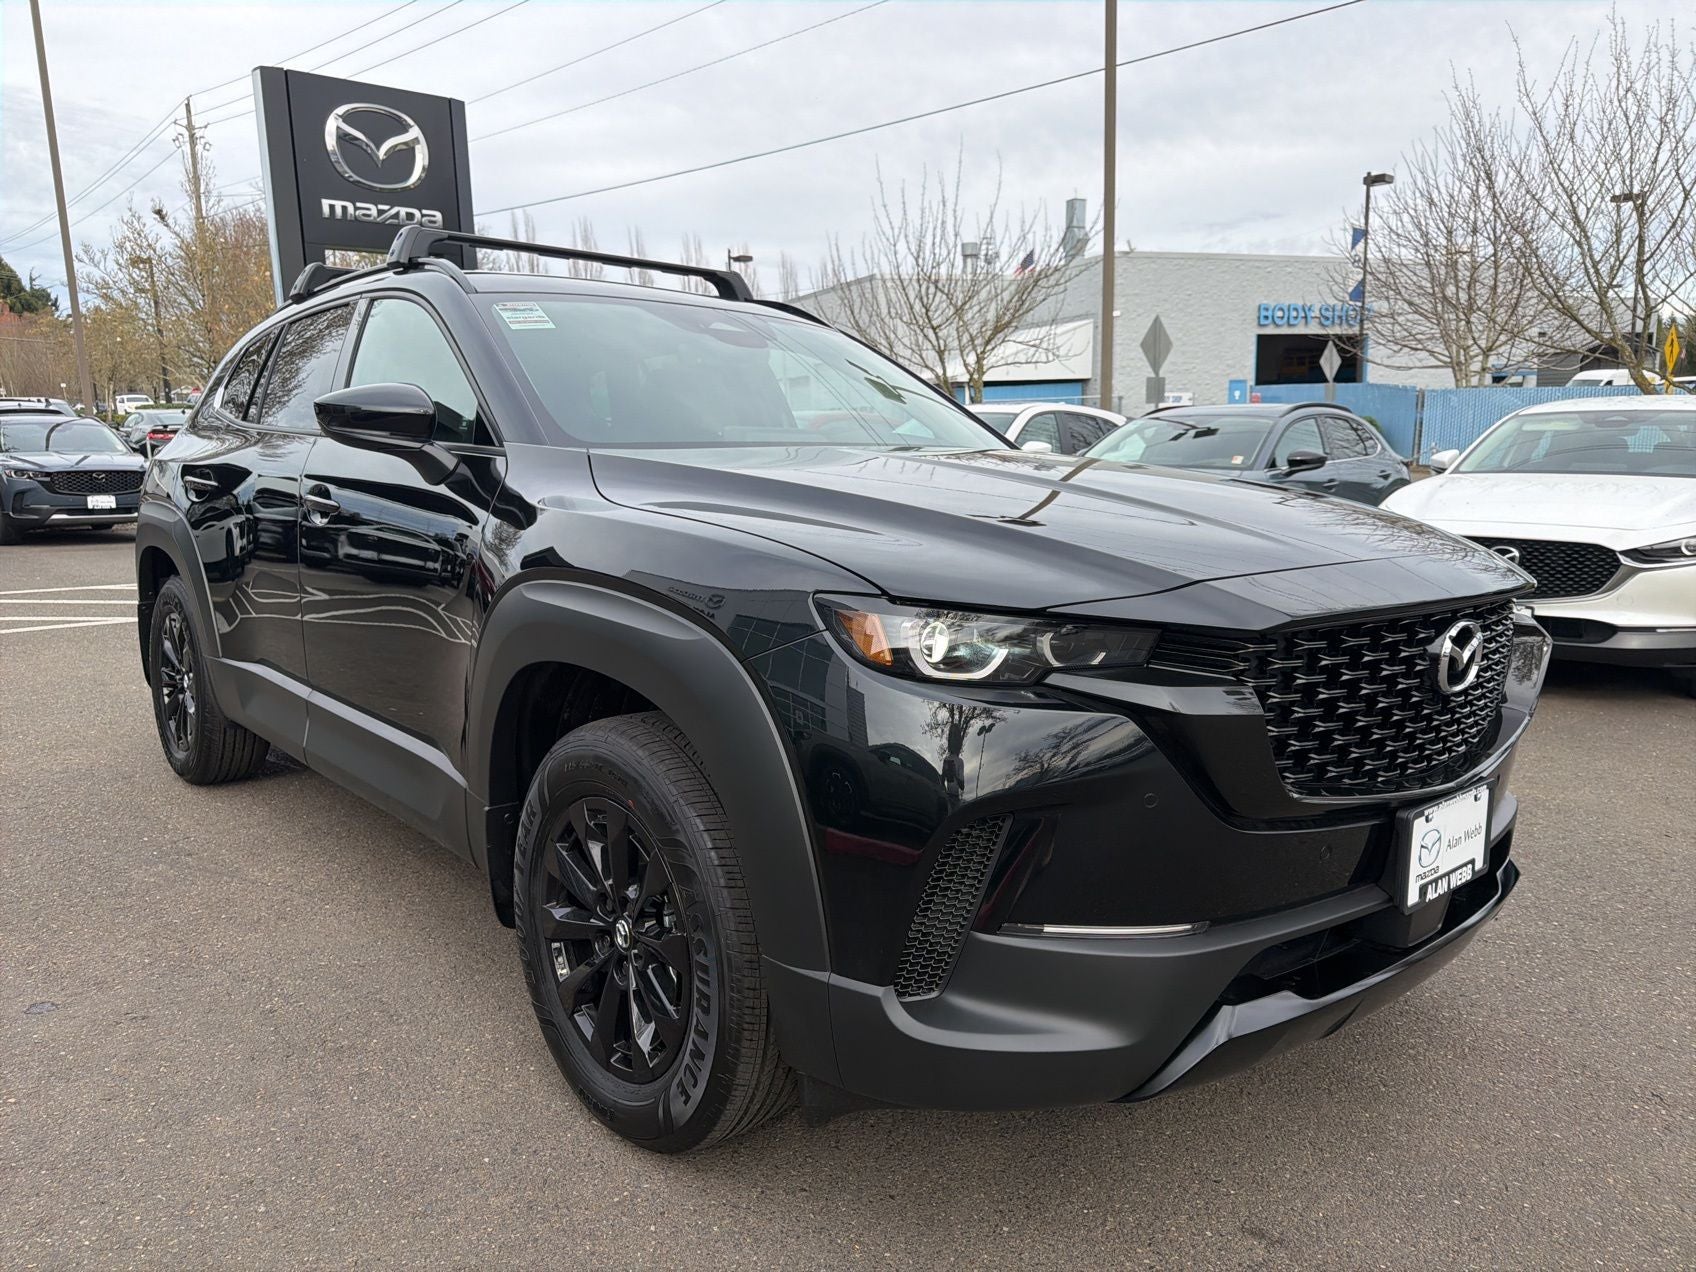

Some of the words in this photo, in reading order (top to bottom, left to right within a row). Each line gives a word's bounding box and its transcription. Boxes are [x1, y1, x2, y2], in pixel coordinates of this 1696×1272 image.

[321, 198, 443, 229] mazda
[1258, 303, 1315, 327] BODY
[1446, 837, 1462, 851] Alan
[1463, 824, 1482, 843] Webb
[1426, 876, 1448, 903] ALAN
[1449, 864, 1473, 890] WEBB
[676, 884, 712, 1107] ASSURANCE
